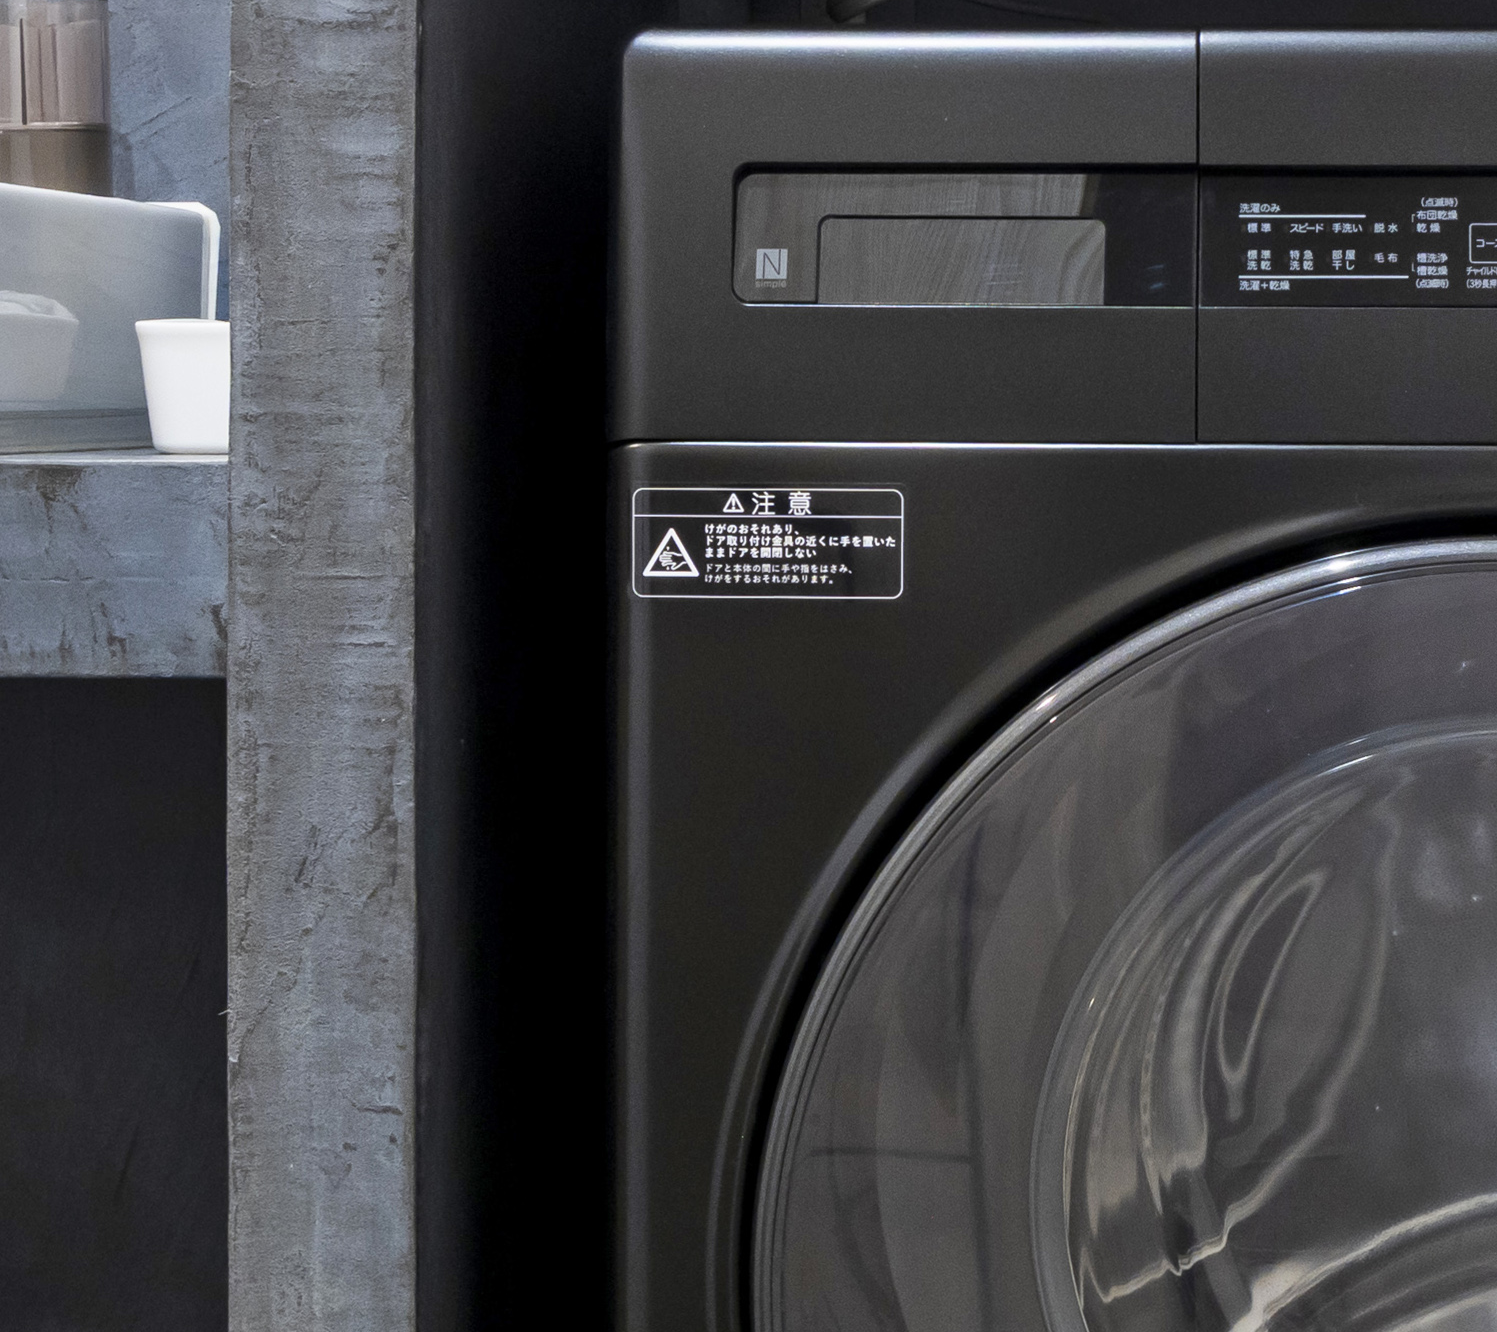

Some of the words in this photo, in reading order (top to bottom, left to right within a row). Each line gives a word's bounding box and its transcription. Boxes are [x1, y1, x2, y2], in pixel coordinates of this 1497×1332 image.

[1239, 202, 1280, 213] 洗濯のみ
[1290, 223, 1324, 232] スピード
[1332, 222, 1362, 233] 手洗い
[755, 279, 787, 288] simple
[751, 491, 812, 515] 注意
[705, 524, 800, 535] けがのおそれあり、
[705, 535, 896, 547] ドア取り付け金具の近くに手を置いた
[705, 547, 816, 558] ままドアを開閉しない
[705, 574, 833, 584] けがをするおそれがあります。
